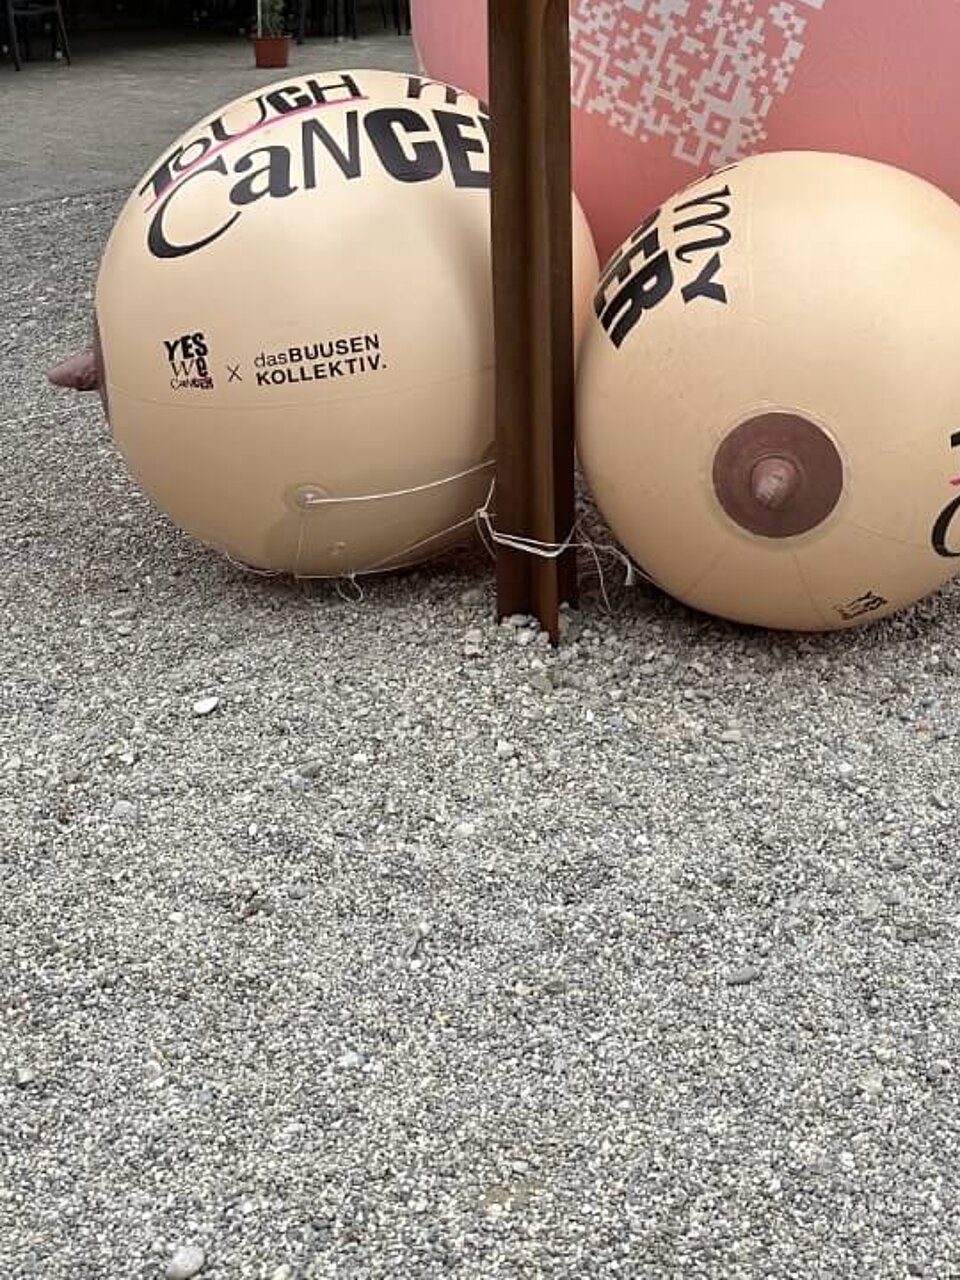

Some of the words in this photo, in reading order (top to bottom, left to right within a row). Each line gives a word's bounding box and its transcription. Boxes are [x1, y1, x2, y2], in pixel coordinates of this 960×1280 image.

[147, 106, 491, 259] CaNCE
[164, 332, 208, 361] YES
[254, 333, 380, 369] dasBUUSEN
[255, 354, 388, 387] KOLLEKTIV.
